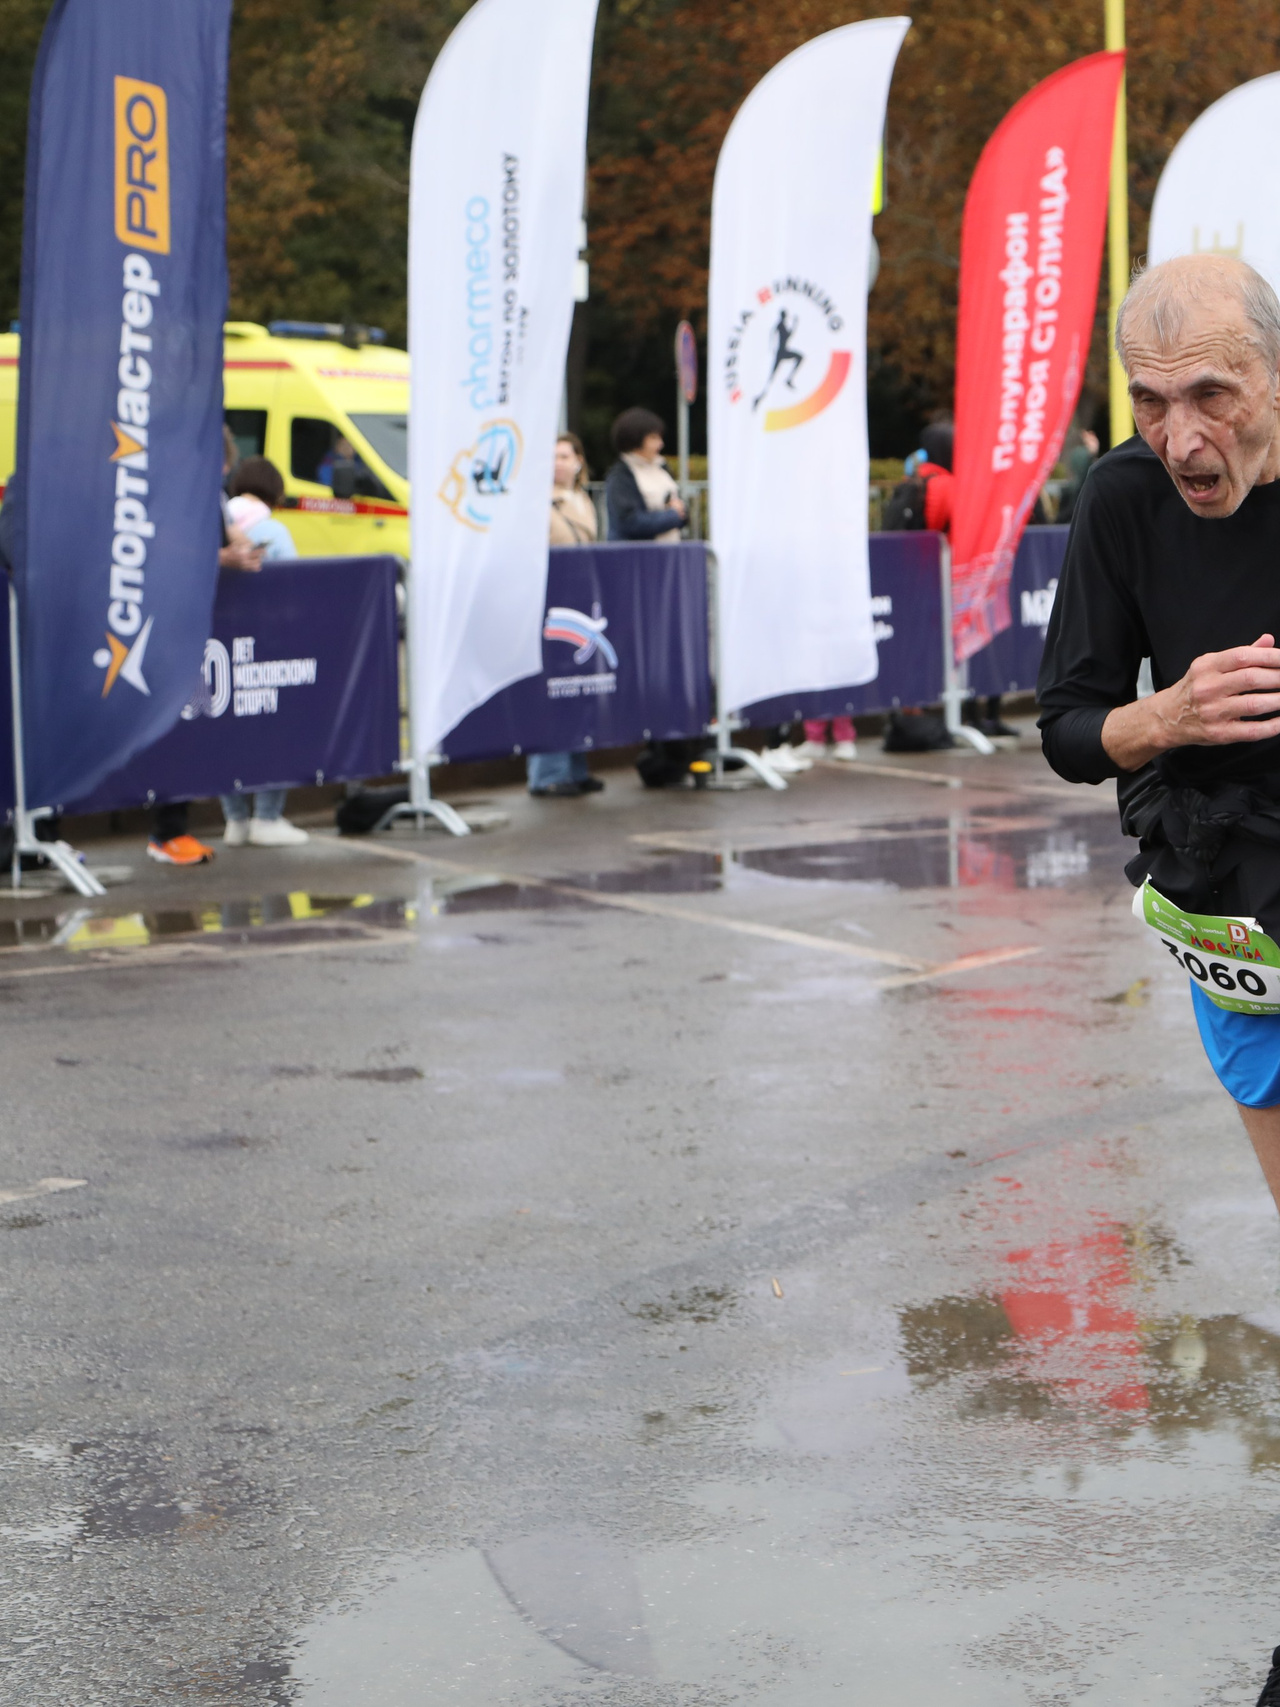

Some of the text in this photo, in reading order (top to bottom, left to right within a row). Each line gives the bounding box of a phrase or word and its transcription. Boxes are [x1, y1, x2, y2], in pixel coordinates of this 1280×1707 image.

[125, 94, 158, 239] PRO
[991, 212, 1035, 473] Полумарафон
[1191, 934, 1265, 962] МОСКВА
